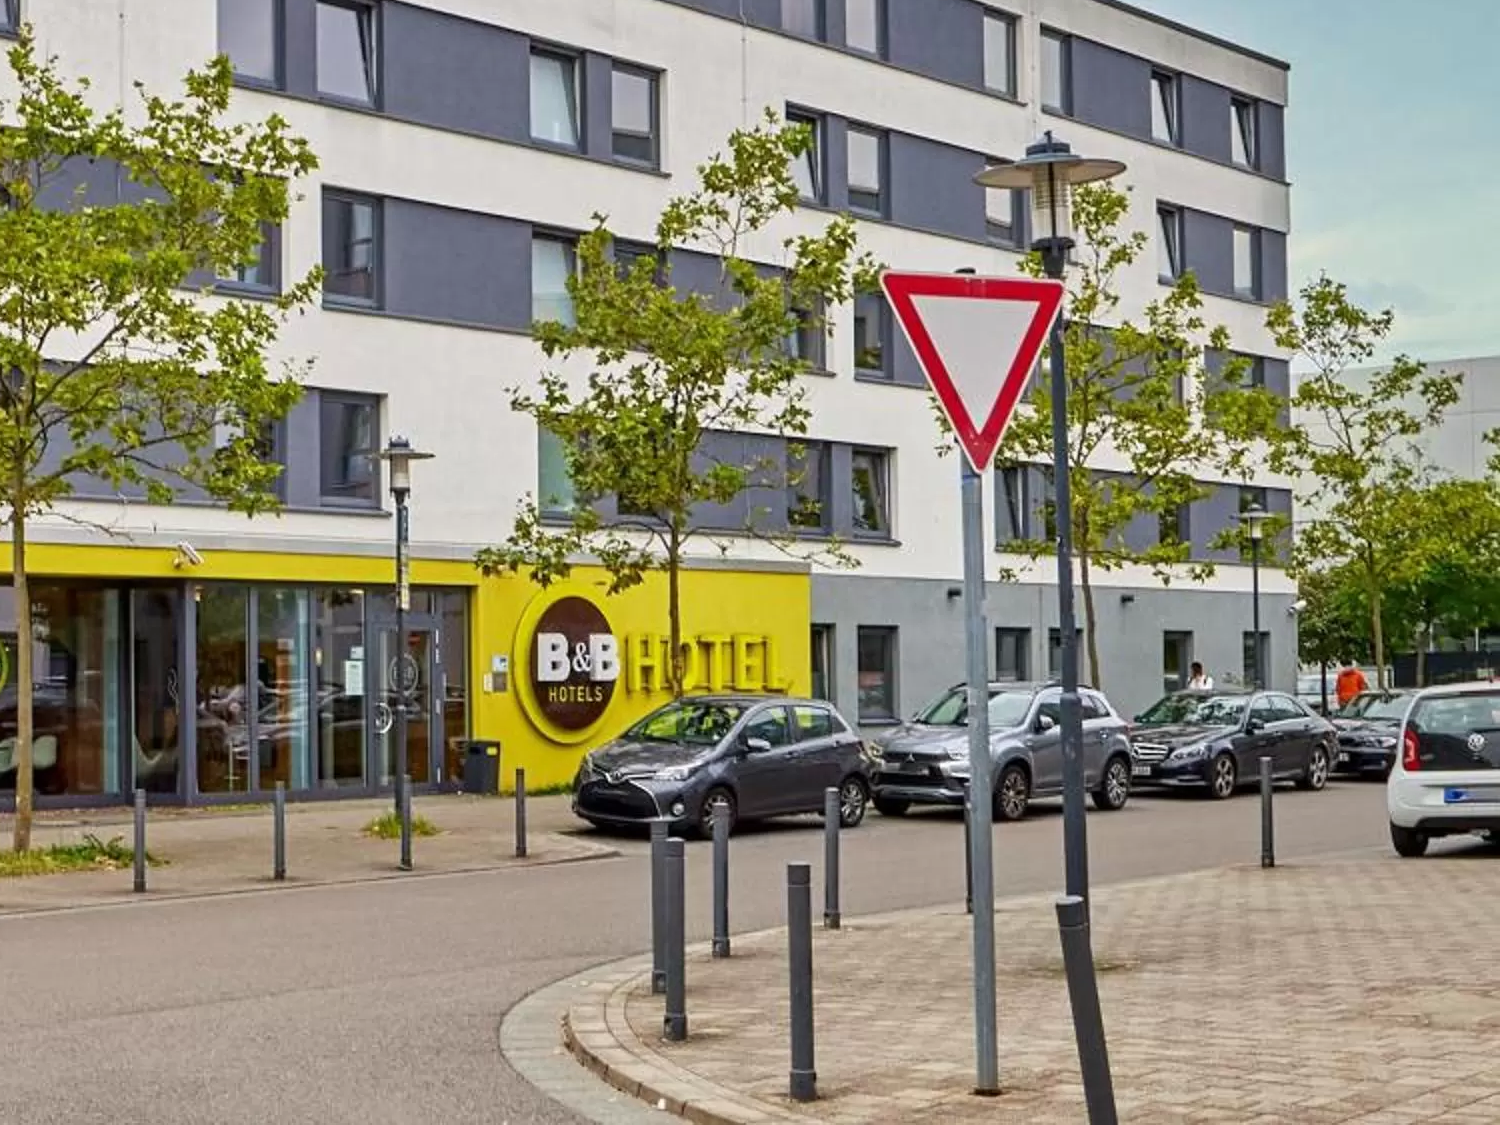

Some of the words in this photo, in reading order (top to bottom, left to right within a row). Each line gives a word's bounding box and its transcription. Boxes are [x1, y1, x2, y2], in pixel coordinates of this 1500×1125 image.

[537, 632, 620, 682] B&B
[626, 632, 790, 693] HOTEL
[548, 686, 603, 703] HOTELS
